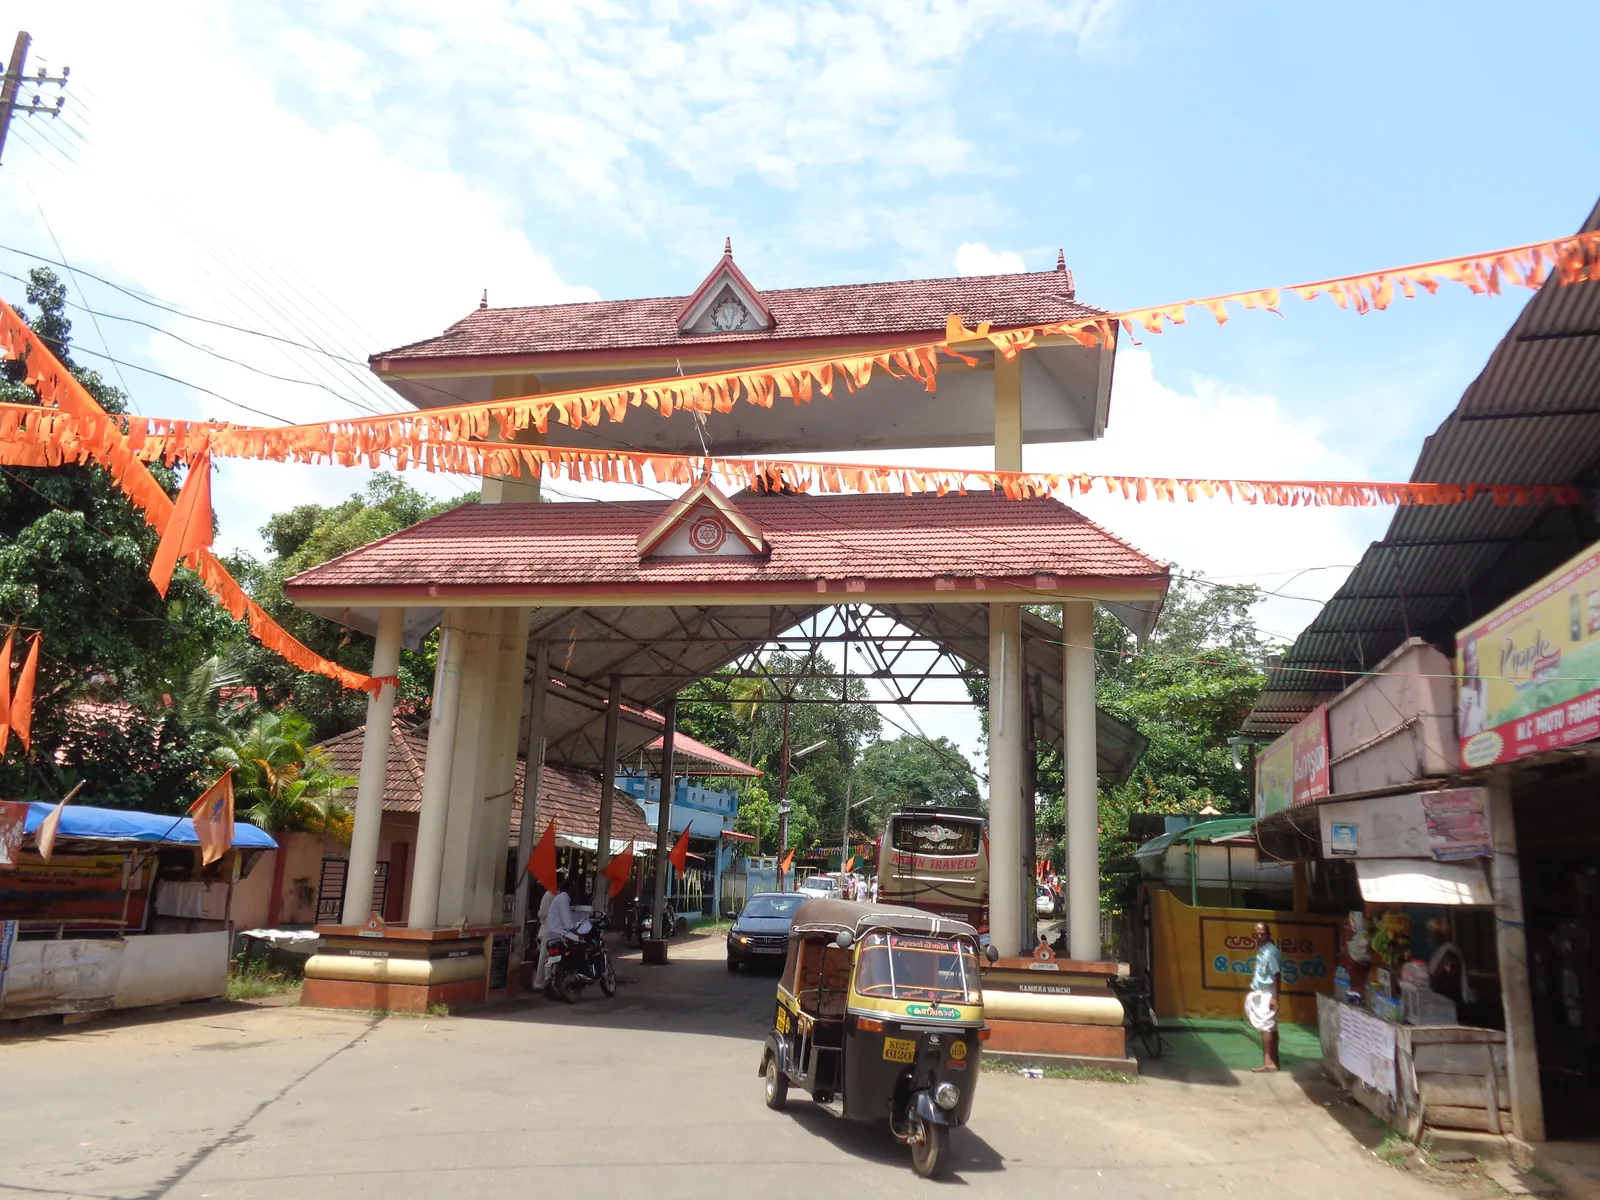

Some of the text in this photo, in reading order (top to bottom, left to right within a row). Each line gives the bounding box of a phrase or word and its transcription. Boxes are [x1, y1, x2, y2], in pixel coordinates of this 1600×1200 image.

[1536, 708, 1565, 735] PHOTO
[920, 842, 935, 850] Air
[930, 859, 977, 870] TRAVELS
[1019, 984, 1071, 995] KANIKKA VANCHI
[885, 1048, 912, 1061] 6120
